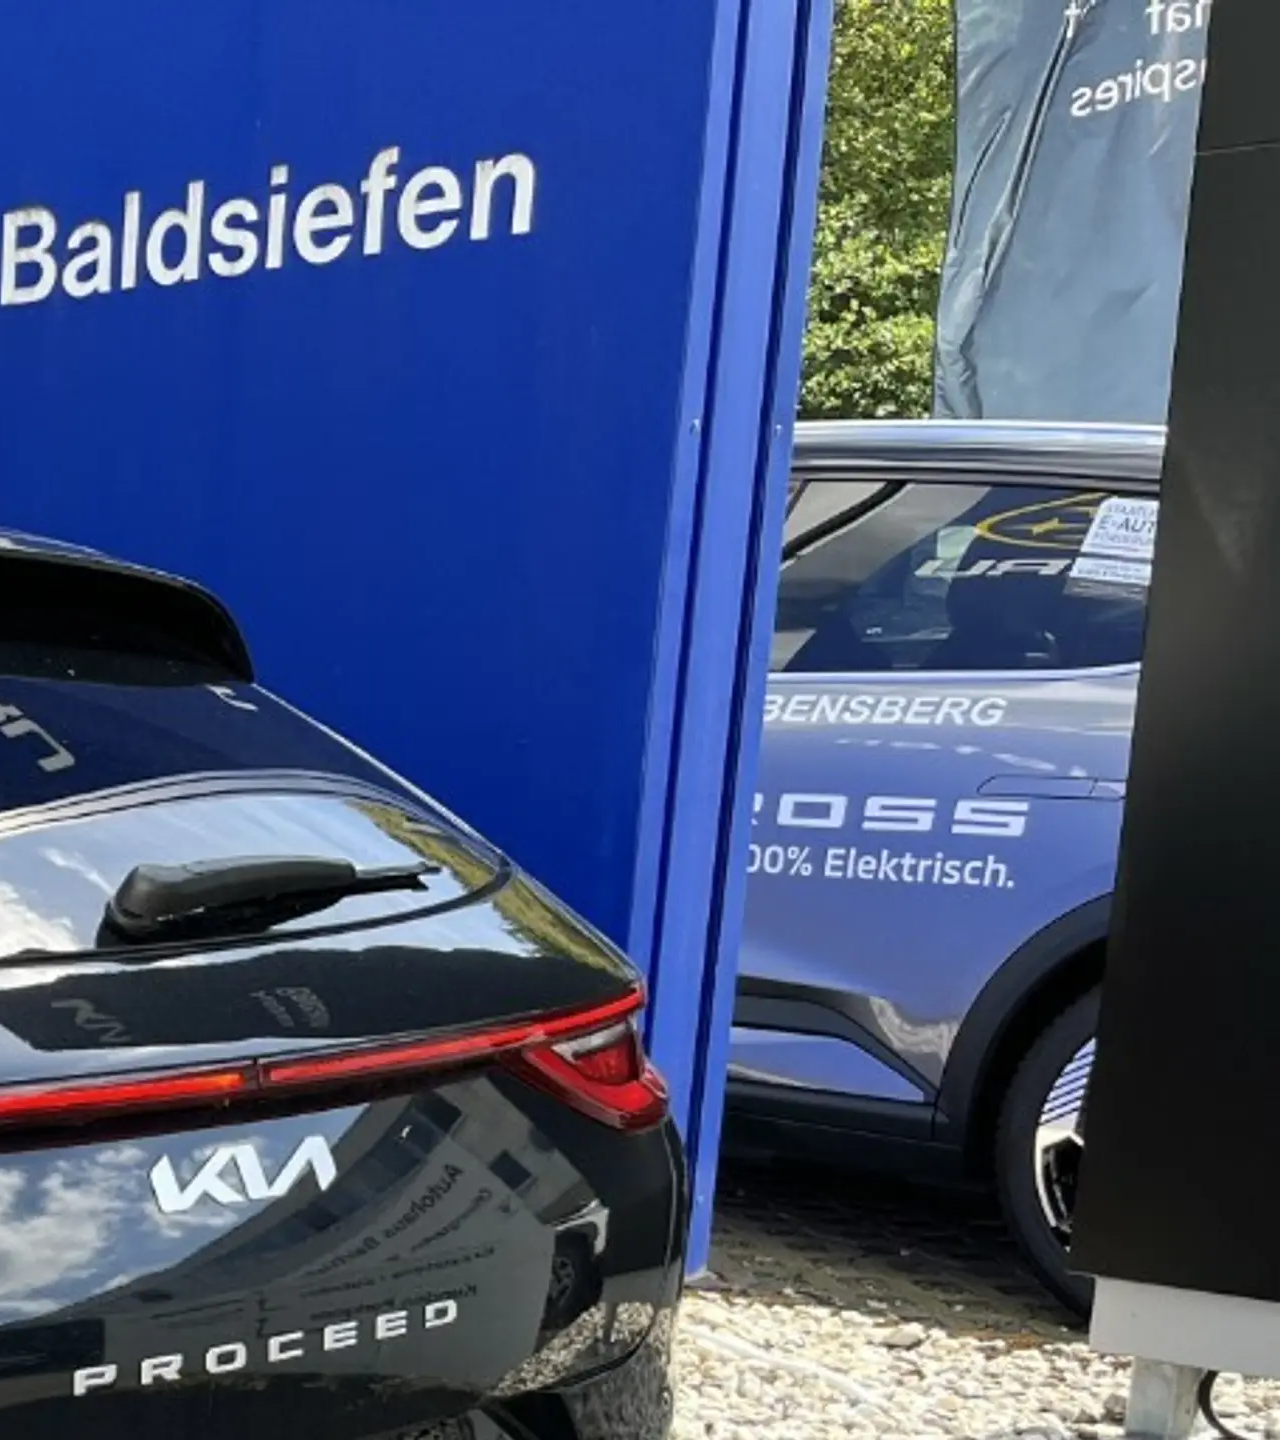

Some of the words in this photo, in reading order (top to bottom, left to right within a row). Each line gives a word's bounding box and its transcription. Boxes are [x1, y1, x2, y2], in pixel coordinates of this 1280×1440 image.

[0, 145, 536, 306] Baldsiefen
[1097, 514, 1155, 534] E-AUT
[763, 694, 1009, 727] BENSBERG
[751, 792, 1030, 837] OSS
[824, 847, 1015, 888] Elektrisch.
[149, 1134, 337, 1213] KIA
[73, 1299, 457, 1397] PROCEED
